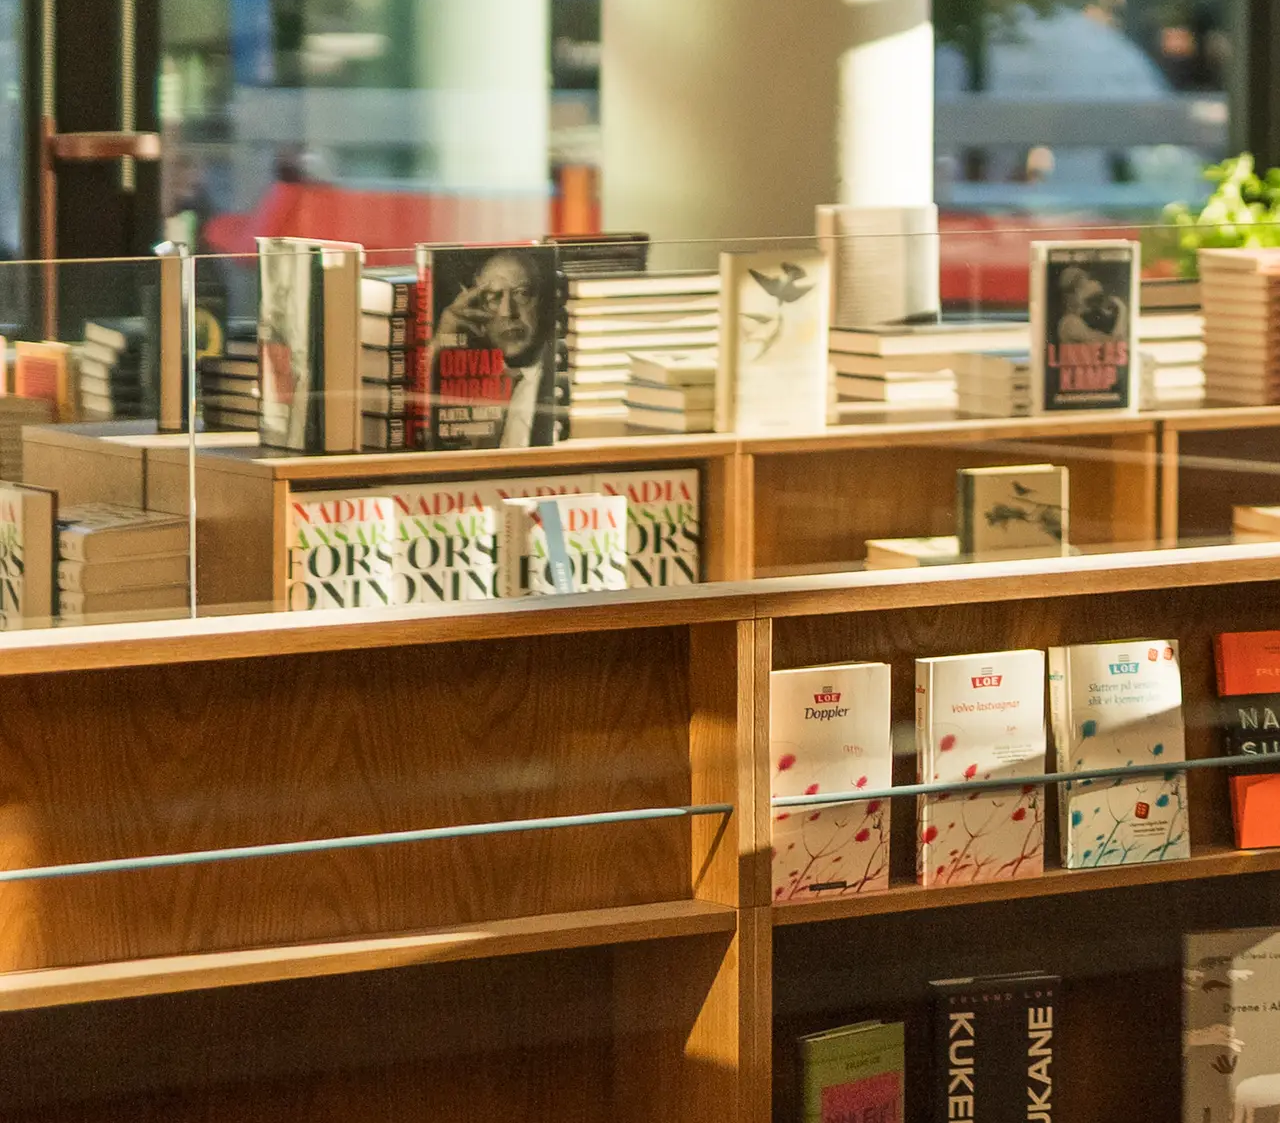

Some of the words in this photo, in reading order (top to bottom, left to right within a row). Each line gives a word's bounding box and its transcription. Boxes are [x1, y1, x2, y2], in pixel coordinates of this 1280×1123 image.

[392, 489, 484, 516] NADIA
[602, 480, 692, 503] NADIA
[292, 499, 384, 524] NADIA
[528, 507, 617, 531] NDIA
[627, 503, 694, 529] NSAR
[297, 523, 388, 550] ANSAR
[534, 530, 620, 558] ASAR
[627, 521, 702, 556] ORS
[395, 534, 492, 570] ORS
[629, 554, 695, 588] NIN
[1113, 664, 1137, 673] LOE
[975, 676, 999, 687] LOE
[817, 693, 838, 703] LOE
[951, 702, 975, 714] Volvo
[804, 706, 850, 721] Doppler
[1223, 1002, 1260, 1014] Dyrene
[948, 1012, 975, 1123] KUKE
